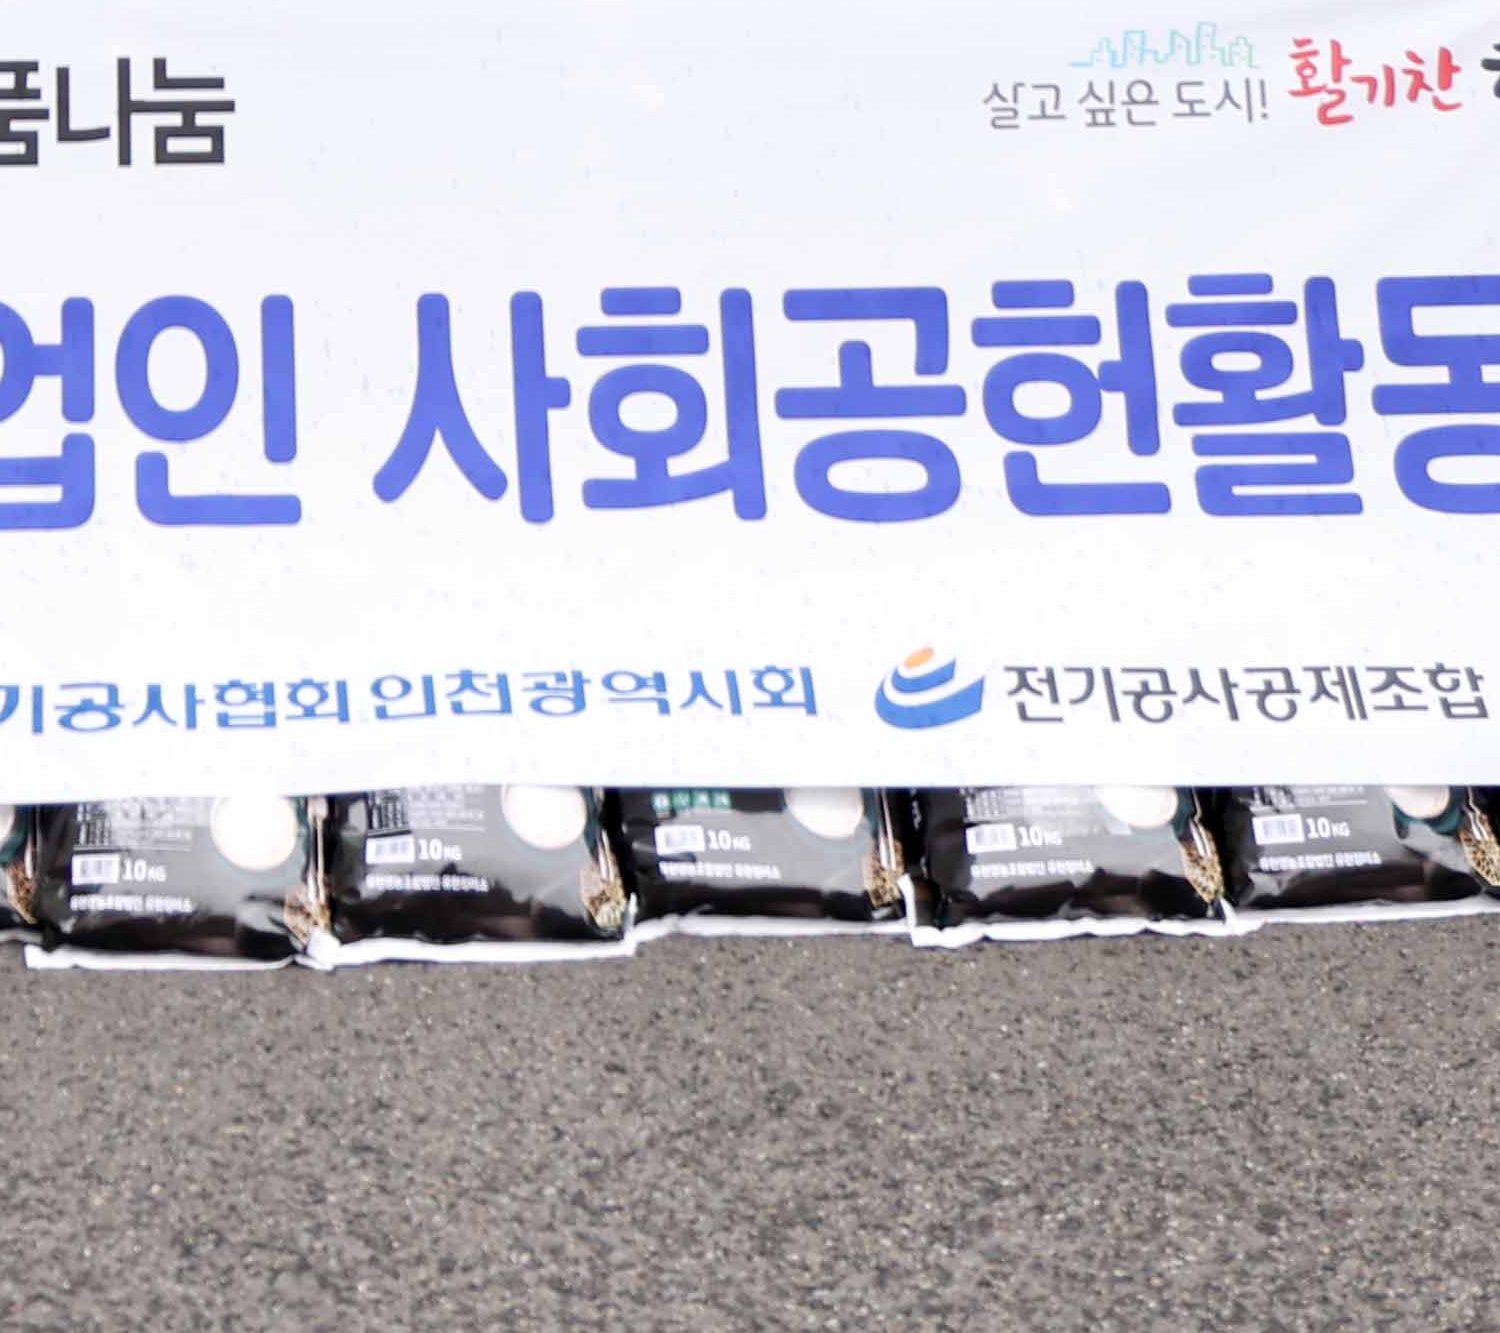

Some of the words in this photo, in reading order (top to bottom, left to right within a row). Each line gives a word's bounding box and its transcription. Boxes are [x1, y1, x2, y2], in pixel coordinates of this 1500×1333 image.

[984, 82, 1066, 129] 살고
[1078, 79, 1159, 127] 싶은
[1173, 77, 1268, 123] 도시!
[1288, 38, 1462, 126] 활기찬
[370, 665, 817, 720] 인천광역시회
[1006, 663, 1488, 723] 전기공사공제조합
